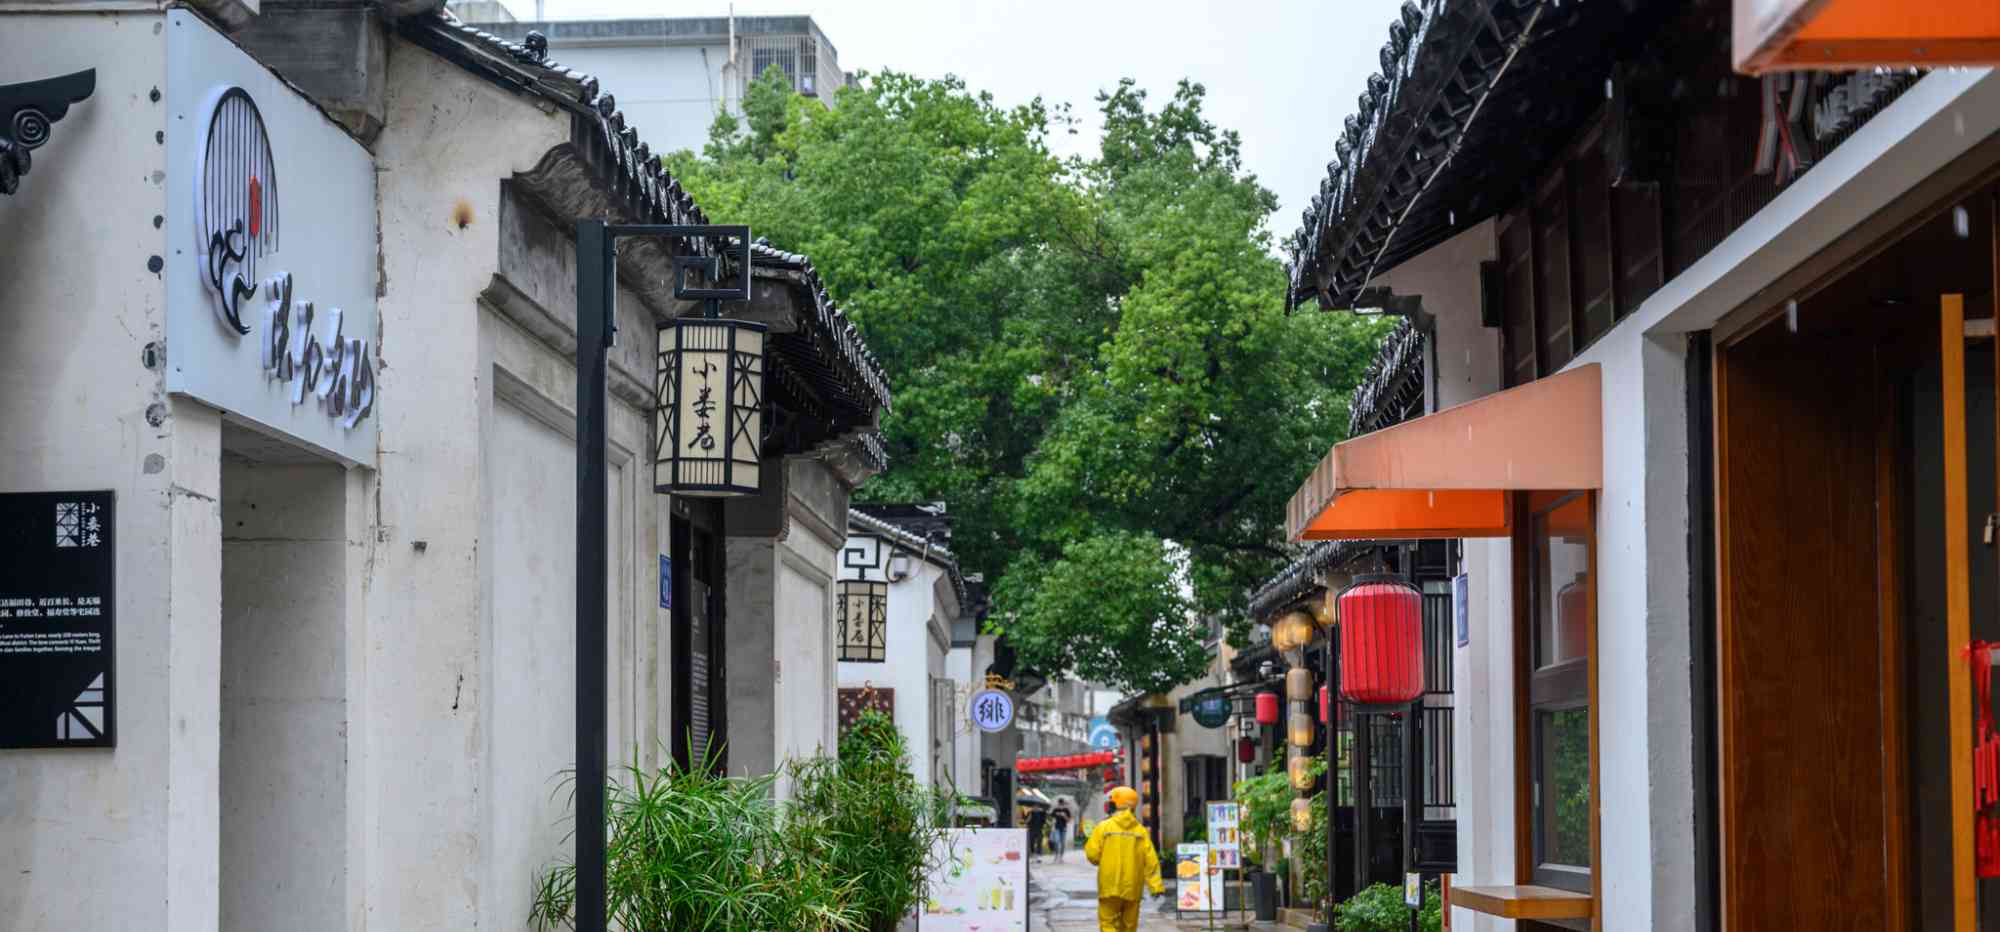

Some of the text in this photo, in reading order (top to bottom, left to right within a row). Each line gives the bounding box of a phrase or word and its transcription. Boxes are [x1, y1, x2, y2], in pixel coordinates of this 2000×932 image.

[688, 361, 717, 449] 小娄巷
[86, 502, 101, 547] 小娄巷
